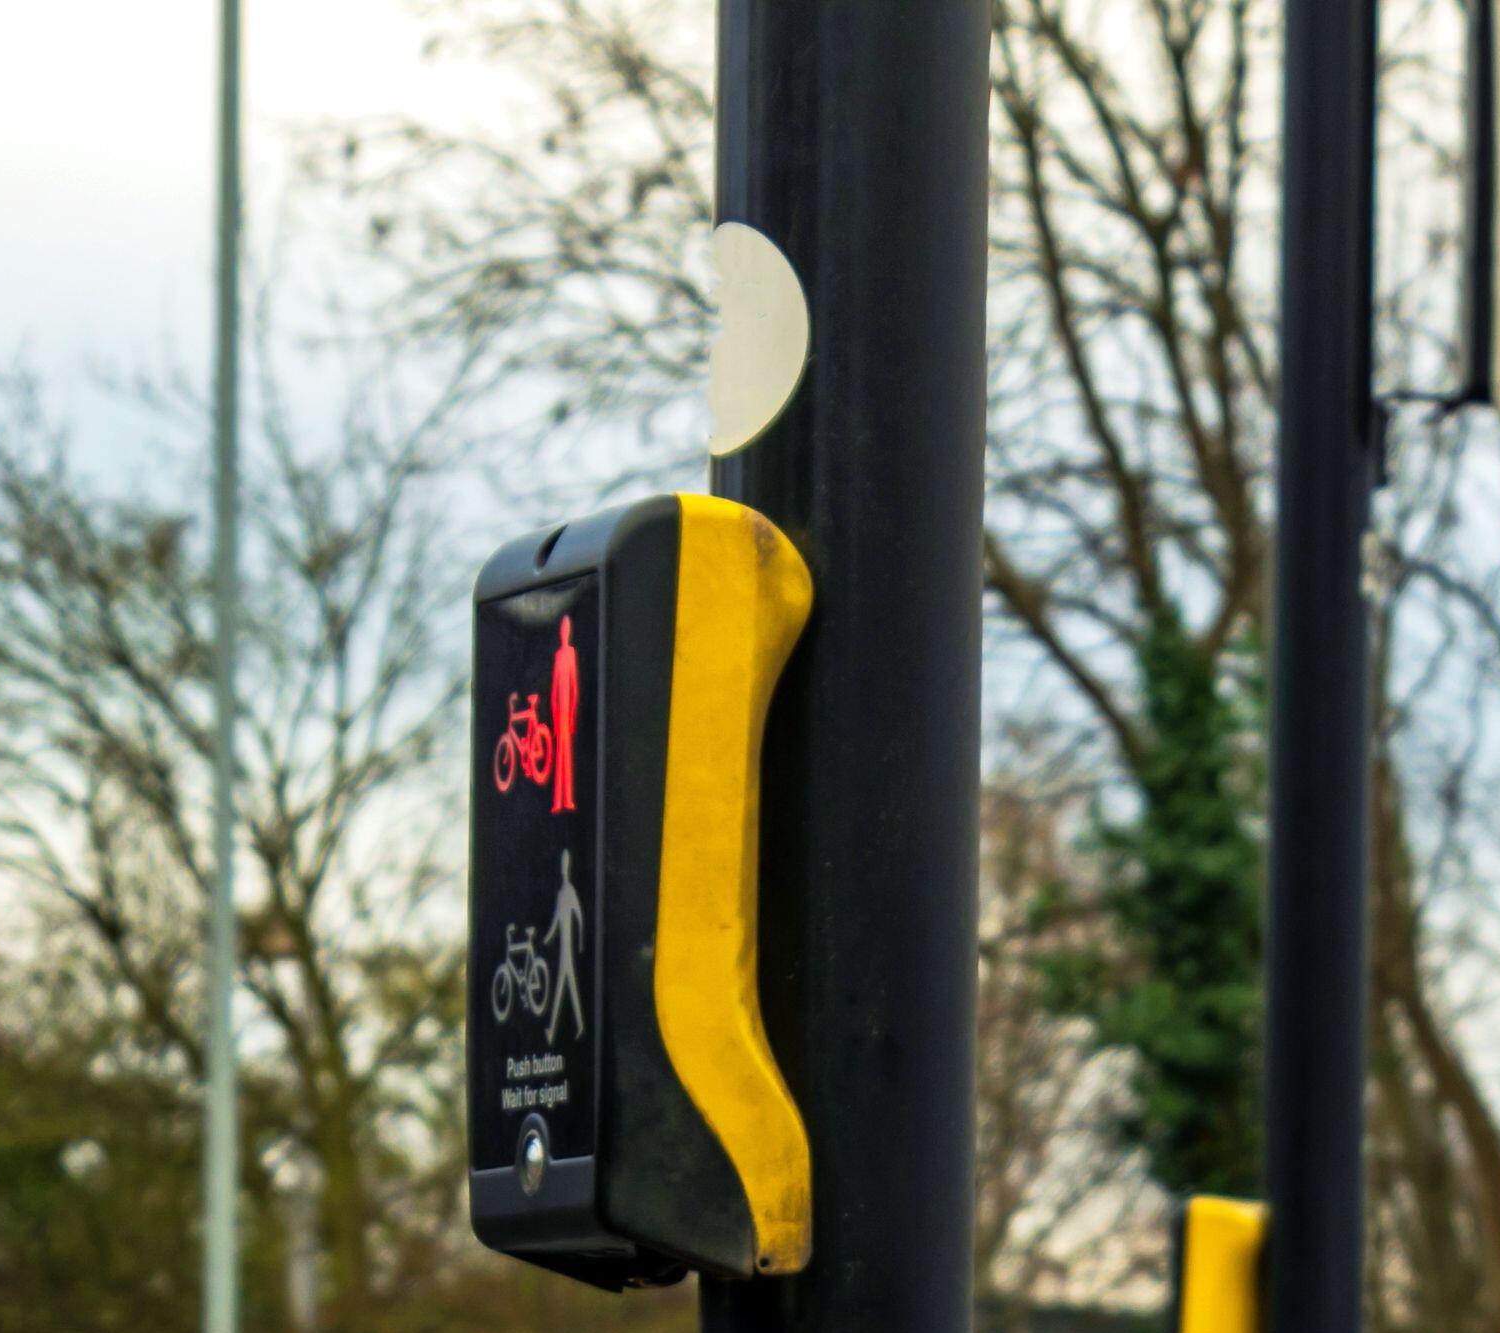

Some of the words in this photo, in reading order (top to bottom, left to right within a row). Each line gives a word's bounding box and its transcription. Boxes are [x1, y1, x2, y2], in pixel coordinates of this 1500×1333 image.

[506, 1055, 531, 1079] Push
[532, 1053, 563, 1075] button
[501, 1086, 522, 1110] Wait
[524, 1084, 538, 1106] for
[539, 1079, 567, 1109] signal
